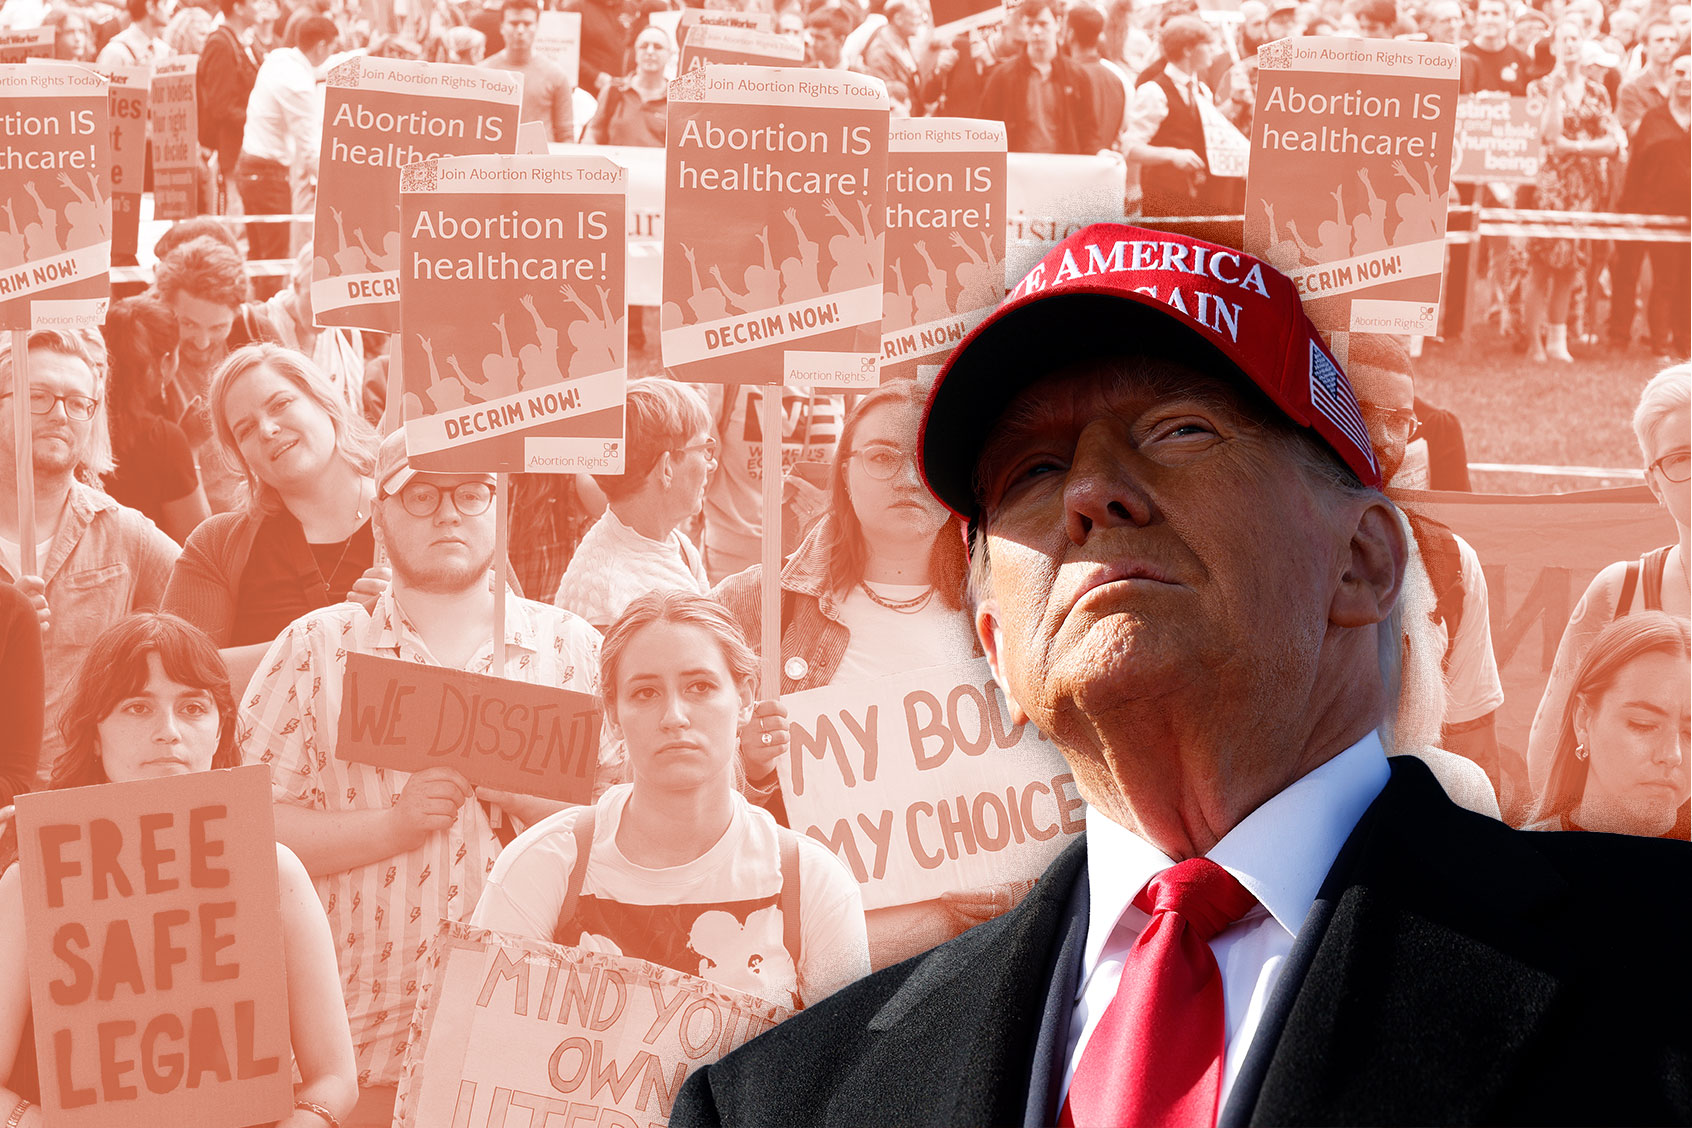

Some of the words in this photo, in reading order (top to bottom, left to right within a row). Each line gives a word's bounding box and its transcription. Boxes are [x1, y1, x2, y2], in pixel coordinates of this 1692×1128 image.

[1294, 48, 1317, 60] Join
[1320, 48, 1373, 62] Abortion
[1376, 51, 1413, 67] Rights
[1417, 54, 1457, 69] Today!
[0, 76, 27, 86] ortion
[30, 75, 64, 88] Rights
[361, 68, 385, 80] Join
[388, 71, 438, 85] Abortion
[441, 76, 477, 89] Rights
[480, 79, 518, 94] Today!
[708, 78, 734, 90] Join
[738, 79, 795, 93] Abortion
[799, 81, 839, 97] Rights
[1264, 86, 1400, 118] Abortion
[1412, 93, 1441, 121] IS
[70, 110, 95, 135] IS
[332, 103, 464, 137] Abortion
[475, 115, 503, 142] IS
[678, 119, 828, 153] Abortion
[842, 126, 872, 155] IS
[888, 129, 921, 141] ortion
[925, 130, 962, 143] Rights
[965, 130, 1005, 142] Today!
[331, 137, 457, 168] health
[1262, 123, 1437, 158] healthcare!
[440, 168, 466, 181] Join
[470, 168, 527, 181] Abortion
[531, 168, 573, 184] Rights
[577, 169, 622, 184] Today!
[679, 160, 869, 196] healthcare!
[885, 166, 953, 193] rtion
[965, 166, 992, 192] IS
[1485, 150, 1539, 177] being
[411, 210, 564, 240] Abortion
[577, 211, 608, 240] IS
[885, 203, 991, 229] thcare!
[0, 271, 30, 295] RIM
[32, 258, 78, 285] NOW!
[413, 252, 607, 281] healthcare!
[1051, 240, 1271, 299] AMERICA
[1293, 267, 1353, 295] ECRIM
[1356, 255, 1402, 283] NOW!
[347, 277, 400, 299] DECRI
[36, 316, 74, 325] Abortion
[704, 314, 784, 350] DECRIM
[787, 302, 840, 332] NOW!
[1355, 316, 1392, 327] Abortion
[1394, 318, 1425, 330] Rights
[880, 334, 917, 360] RIM
[920, 321, 966, 349] NOW!
[789, 369, 832, 382] Abortion
[834, 371, 867, 384] Rights
[444, 401, 525, 440] DECRIM
[528, 388, 582, 419] NOW!
[530, 456, 574, 466] Abortion
[577, 456, 609, 469] Rights
[350, 671, 416, 746] WE
[427, 682, 600, 778] DISSENT
[790, 704, 878, 796] MY
[903, 679, 1050, 771] BOD
[806, 809, 893, 884] MY
[906, 772, 1087, 870] CHOICE
[39, 805, 231, 909] FREE
[49, 901, 240, 1006] SAFE
[476, 947, 628, 1032] MIND
[642, 980, 778, 1061] YOU
[54, 999, 280, 1110] LEGAL
[548, 1036, 688, 1119] OWN
